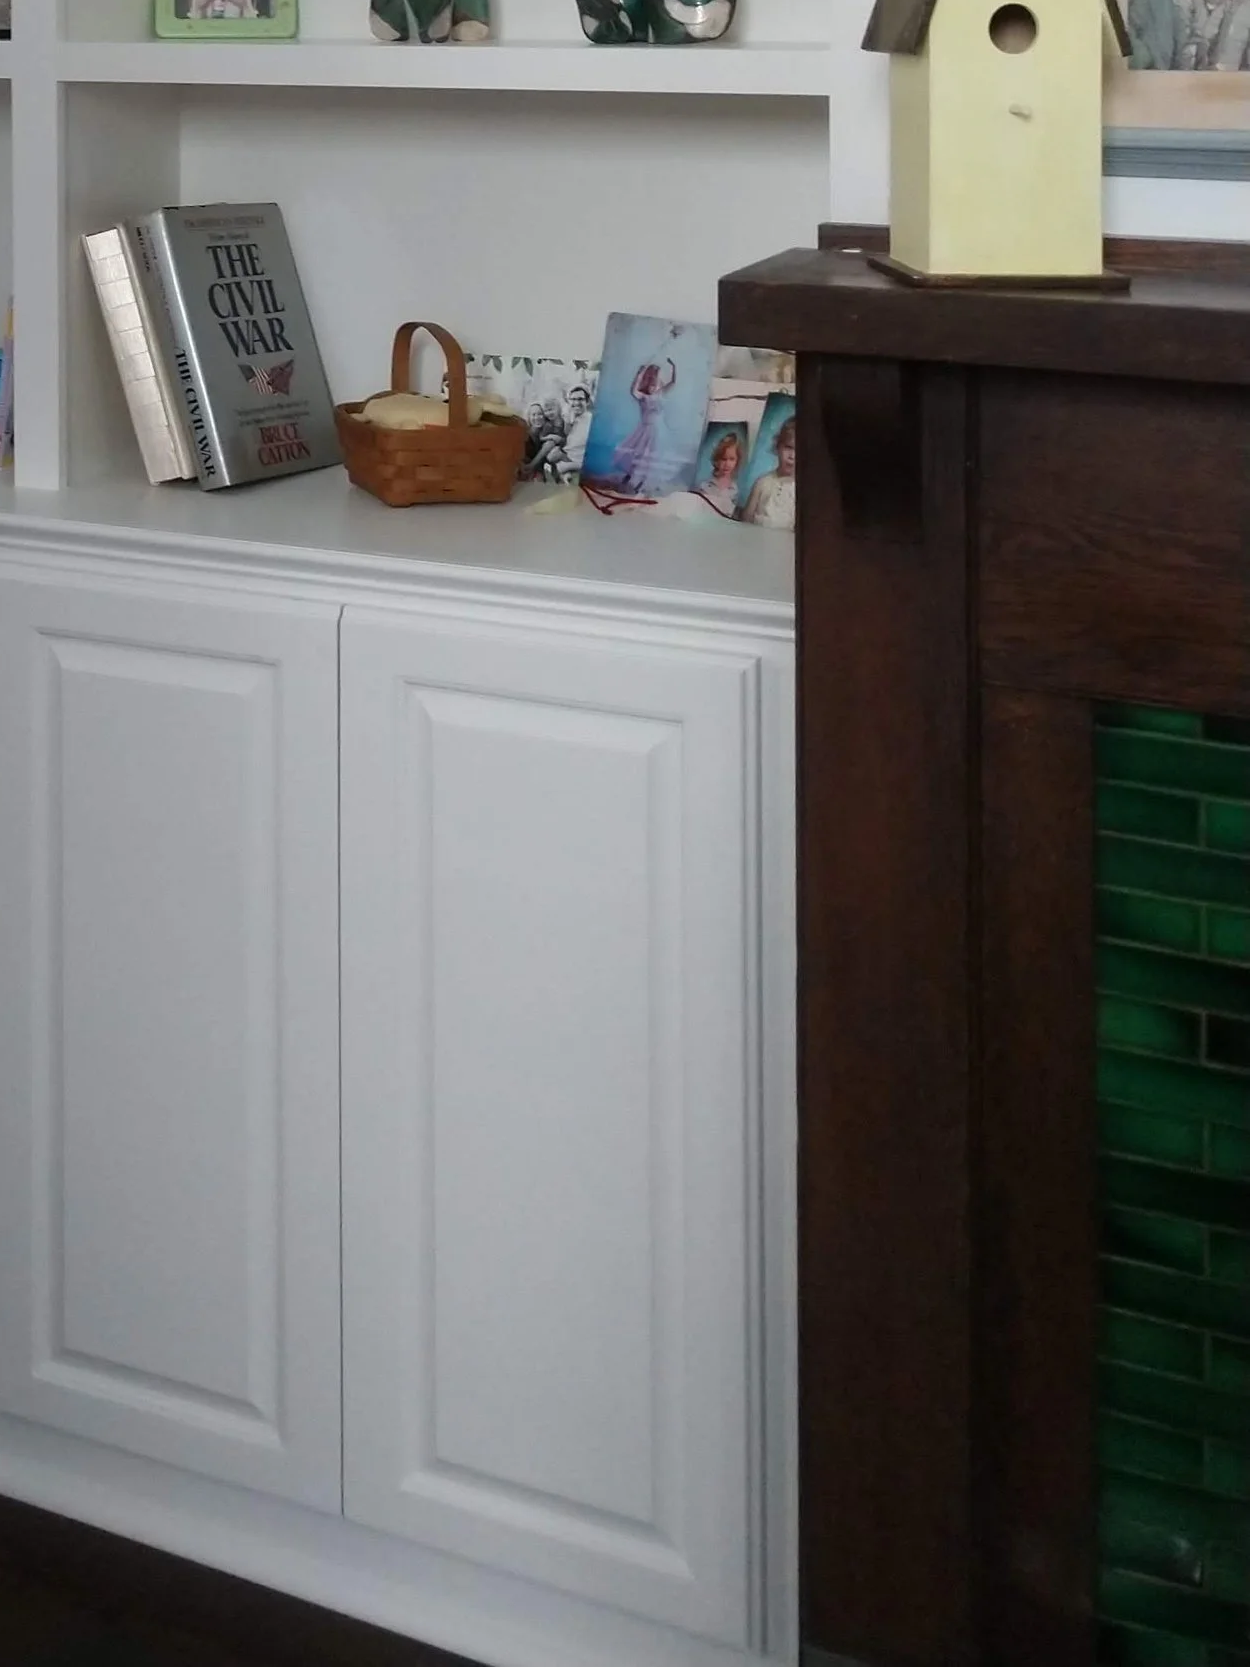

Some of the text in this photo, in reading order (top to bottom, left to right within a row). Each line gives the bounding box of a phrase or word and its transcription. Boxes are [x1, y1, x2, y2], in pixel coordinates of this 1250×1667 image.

[206, 243, 265, 279] THE
[208, 278, 286, 319] CIVIL
[218, 317, 294, 358] WAR
[175, 348, 217, 478] THE CIVIL WAR
[258, 421, 300, 445] BRUCE
[258, 440, 312, 467] CATTON
